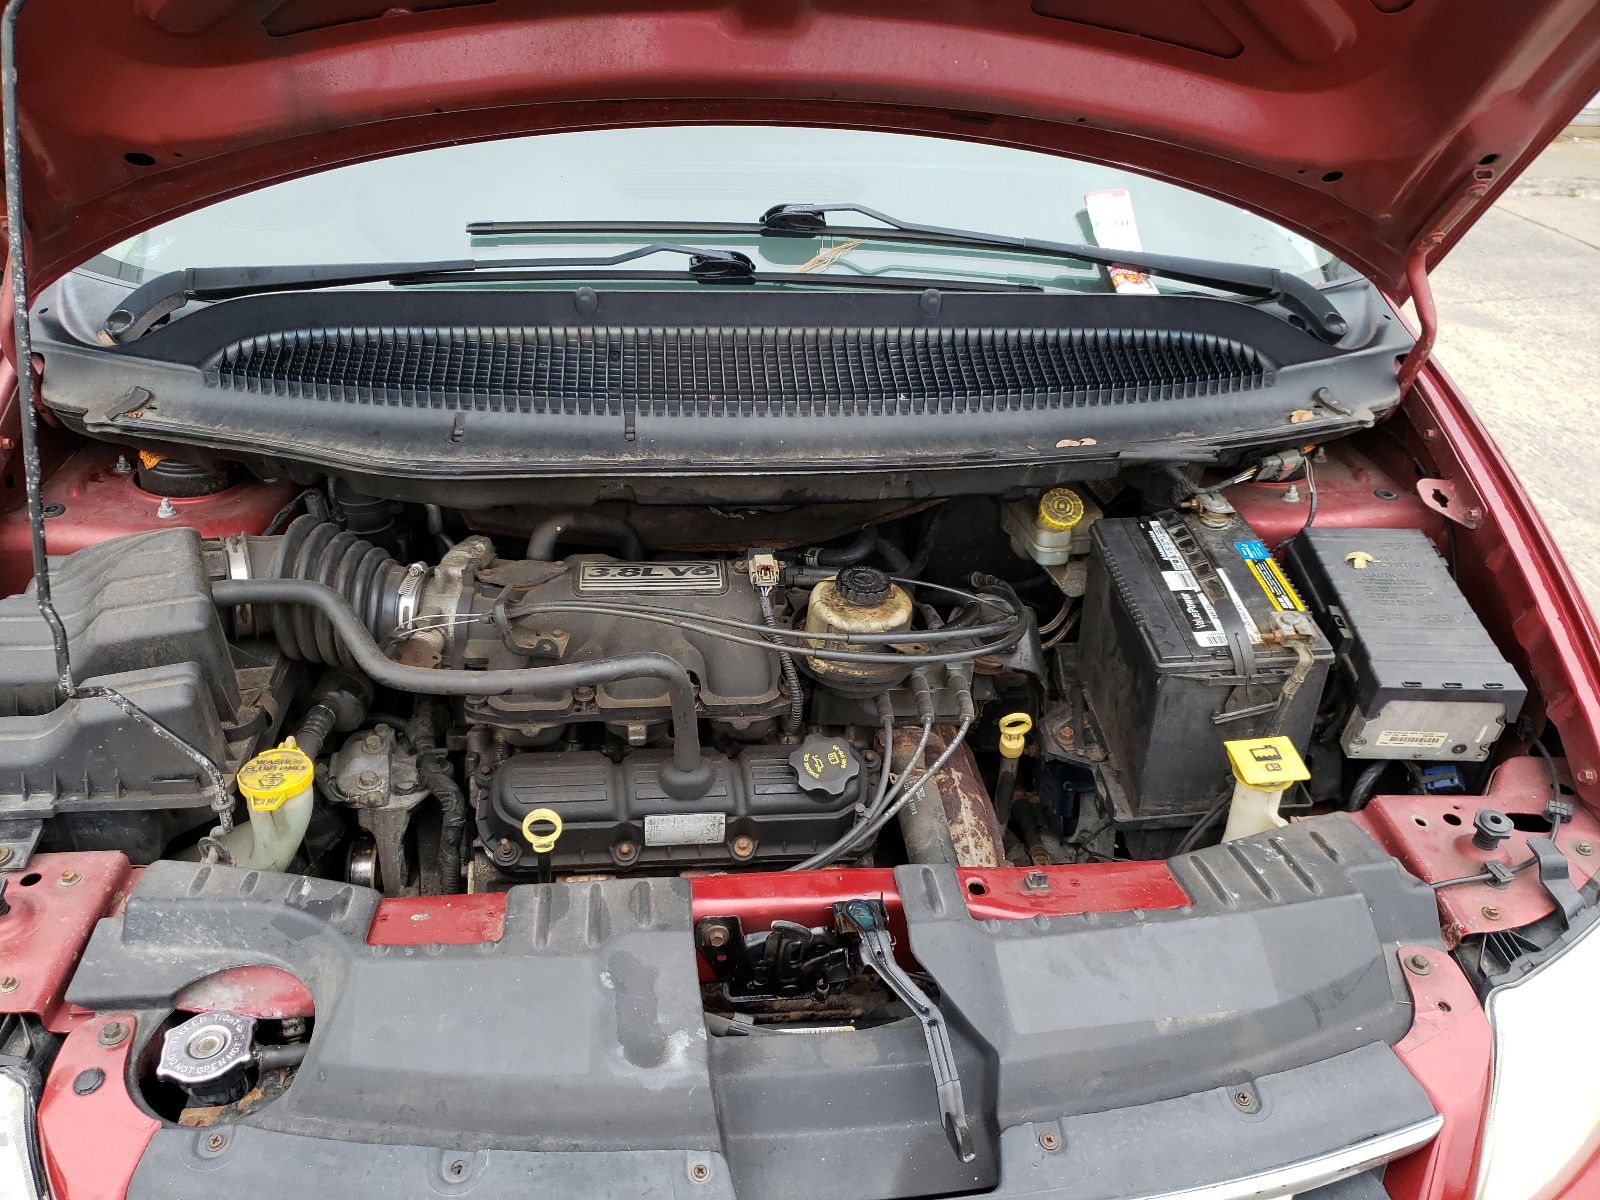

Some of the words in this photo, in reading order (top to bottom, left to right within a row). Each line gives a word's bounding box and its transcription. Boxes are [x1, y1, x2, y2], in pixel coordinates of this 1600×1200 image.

[588, 567, 664, 578] 3.8L
[668, 566, 715, 577] V6
[179, 1016, 207, 1035] KEEP
[213, 1013, 242, 1026] TIGHT
[174, 1062, 194, 1075] NOT
[196, 1058, 227, 1074] OPEN
[226, 1042, 242, 1059] HOT
